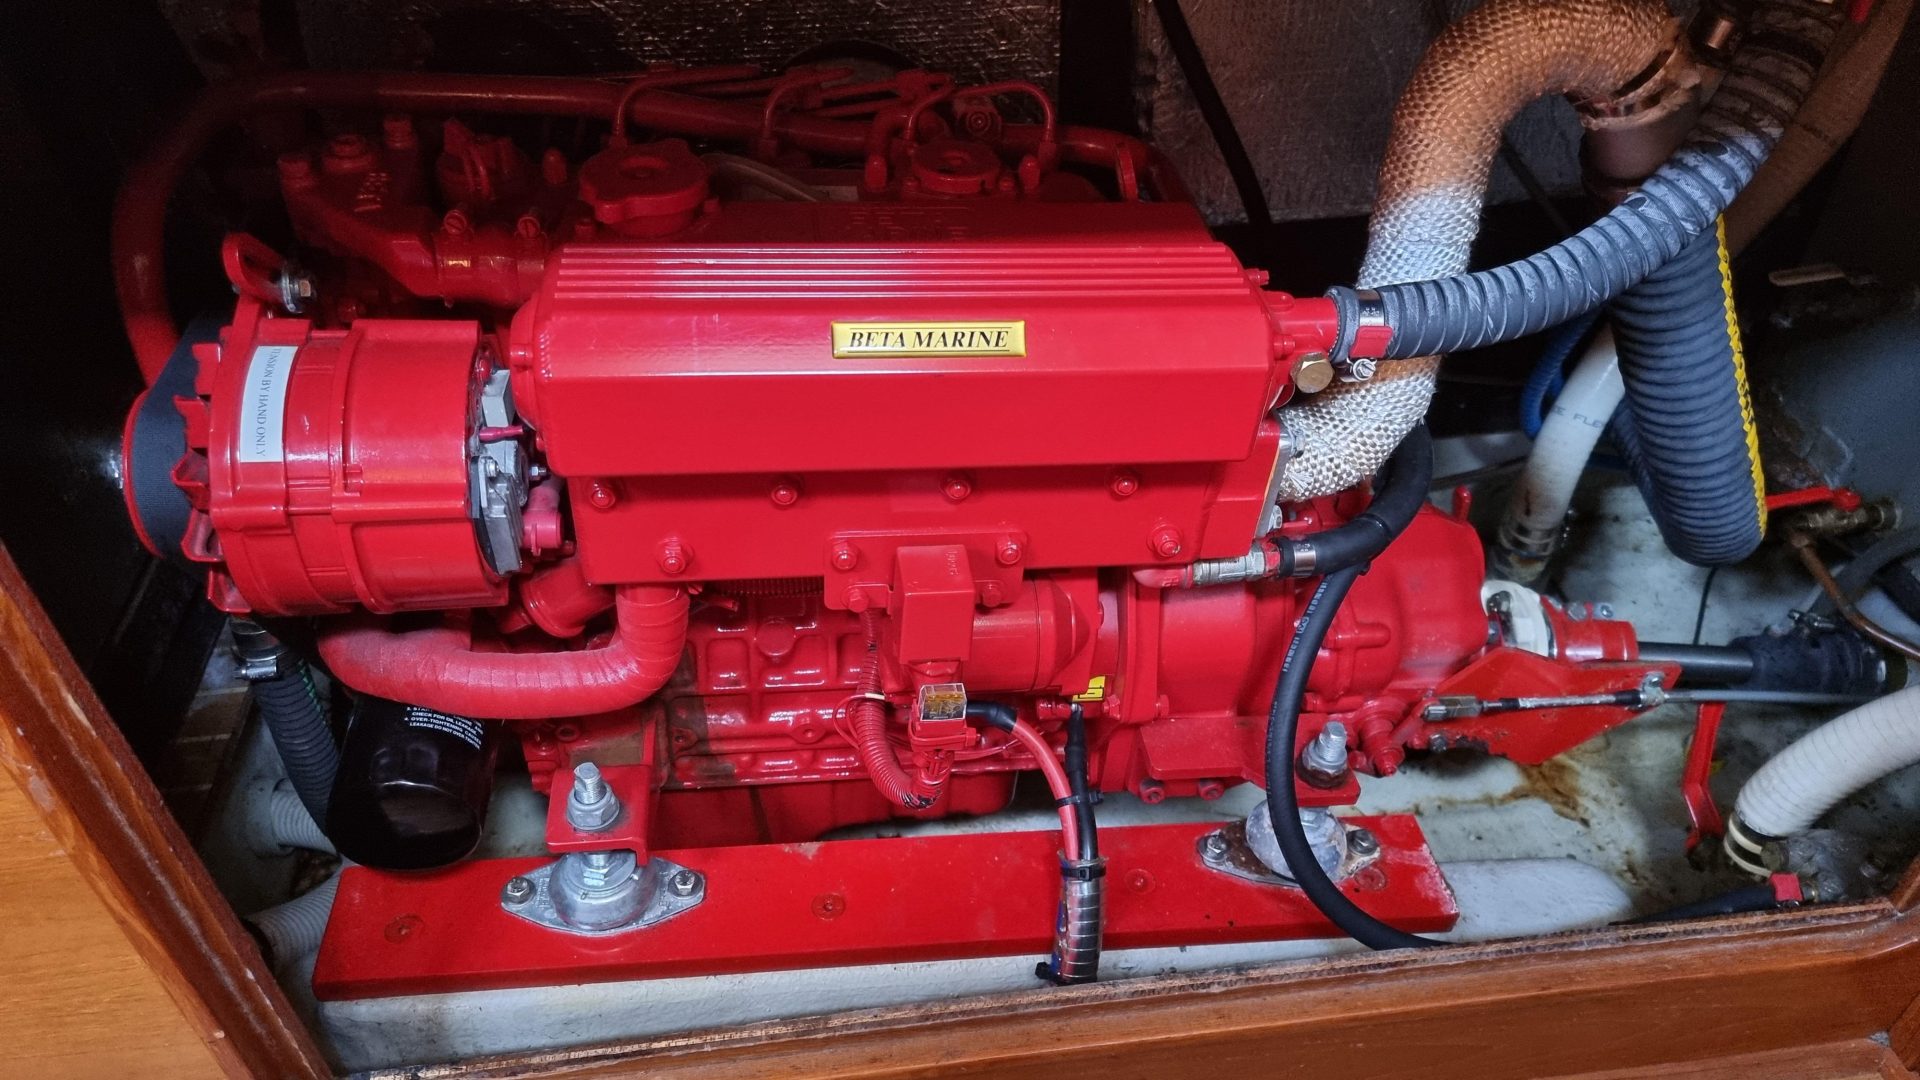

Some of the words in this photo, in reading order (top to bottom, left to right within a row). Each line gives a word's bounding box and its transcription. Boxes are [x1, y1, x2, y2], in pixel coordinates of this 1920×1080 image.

[850, 331, 906, 347] BETA
[912, 331, 1009, 347] MARINE
[261, 379, 272, 392] BY
[257, 394, 269, 425] HAND
[256, 427, 266, 457] ONLY
[453, 730, 465, 738] OVER
